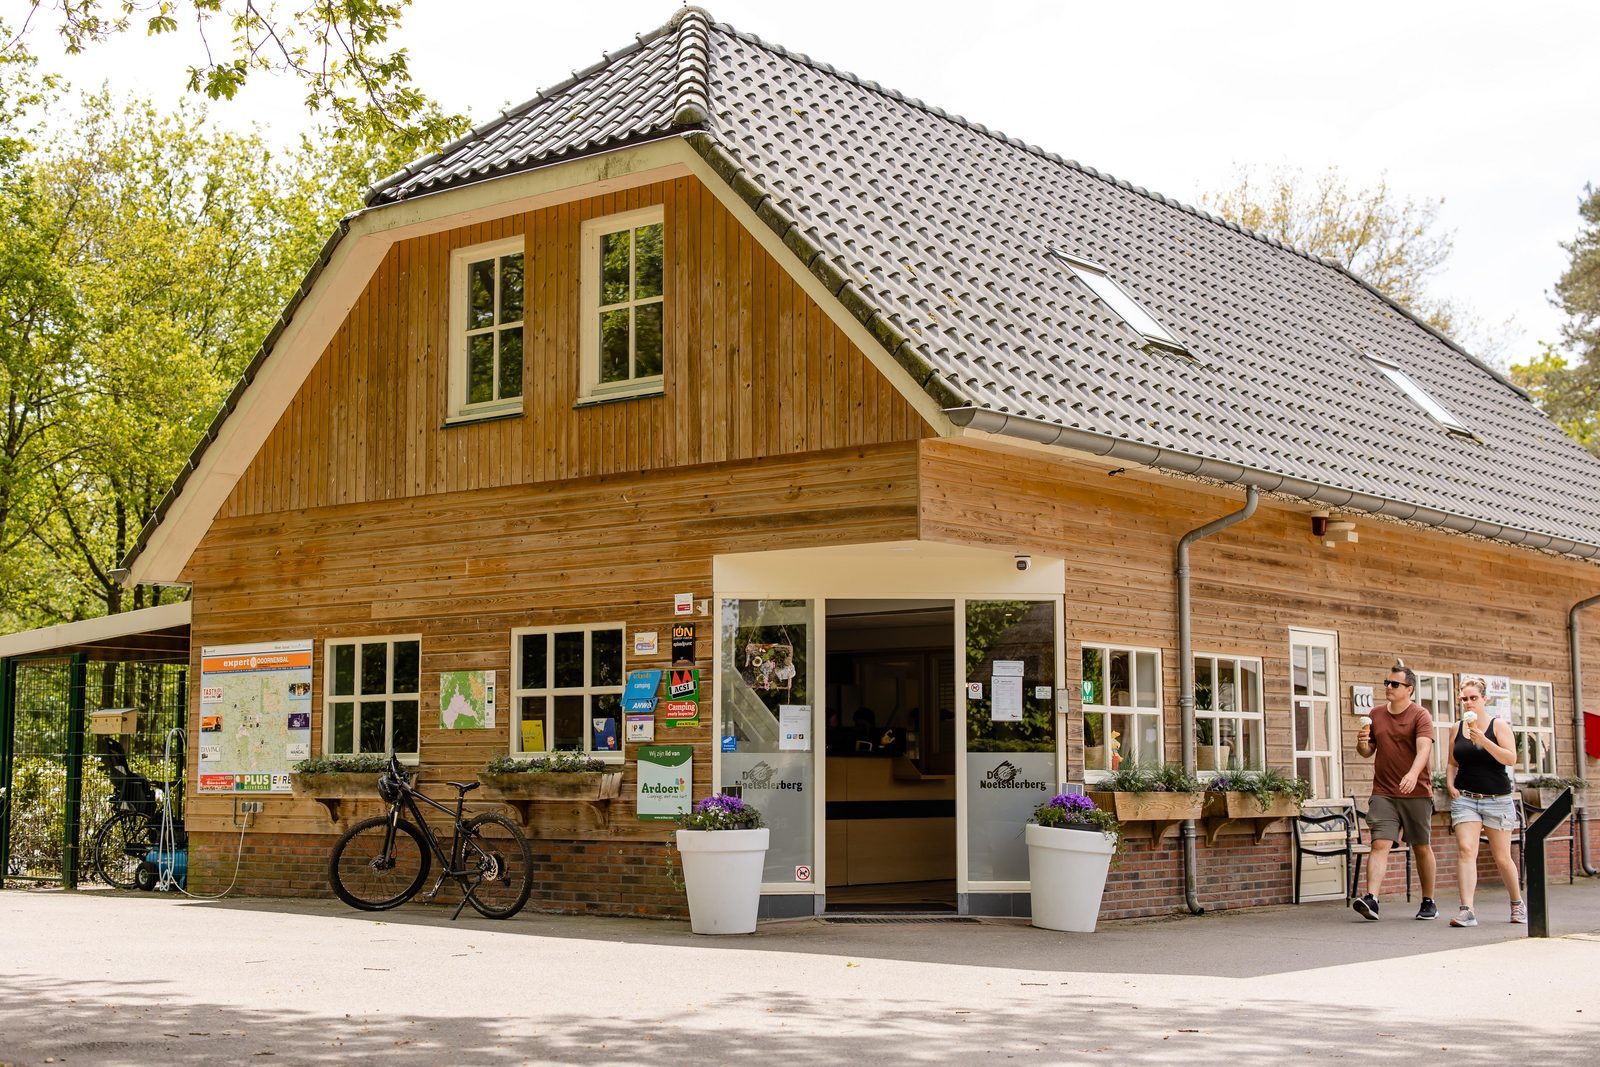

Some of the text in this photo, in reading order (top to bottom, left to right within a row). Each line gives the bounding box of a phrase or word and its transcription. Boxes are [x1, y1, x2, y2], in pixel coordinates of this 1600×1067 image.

[673, 626, 693, 637] ION
[223, 658, 250, 668] expert
[674, 684, 690, 693] ACSI
[667, 702, 696, 712] Camping
[648, 750, 656, 758] Wij
[656, 750, 664, 758] zijn
[244, 774, 270, 785] PLUS
[986, 771, 998, 780] De
[641, 782, 680, 794] Ardoer
[980, 780, 1046, 791] Noetselerberg
